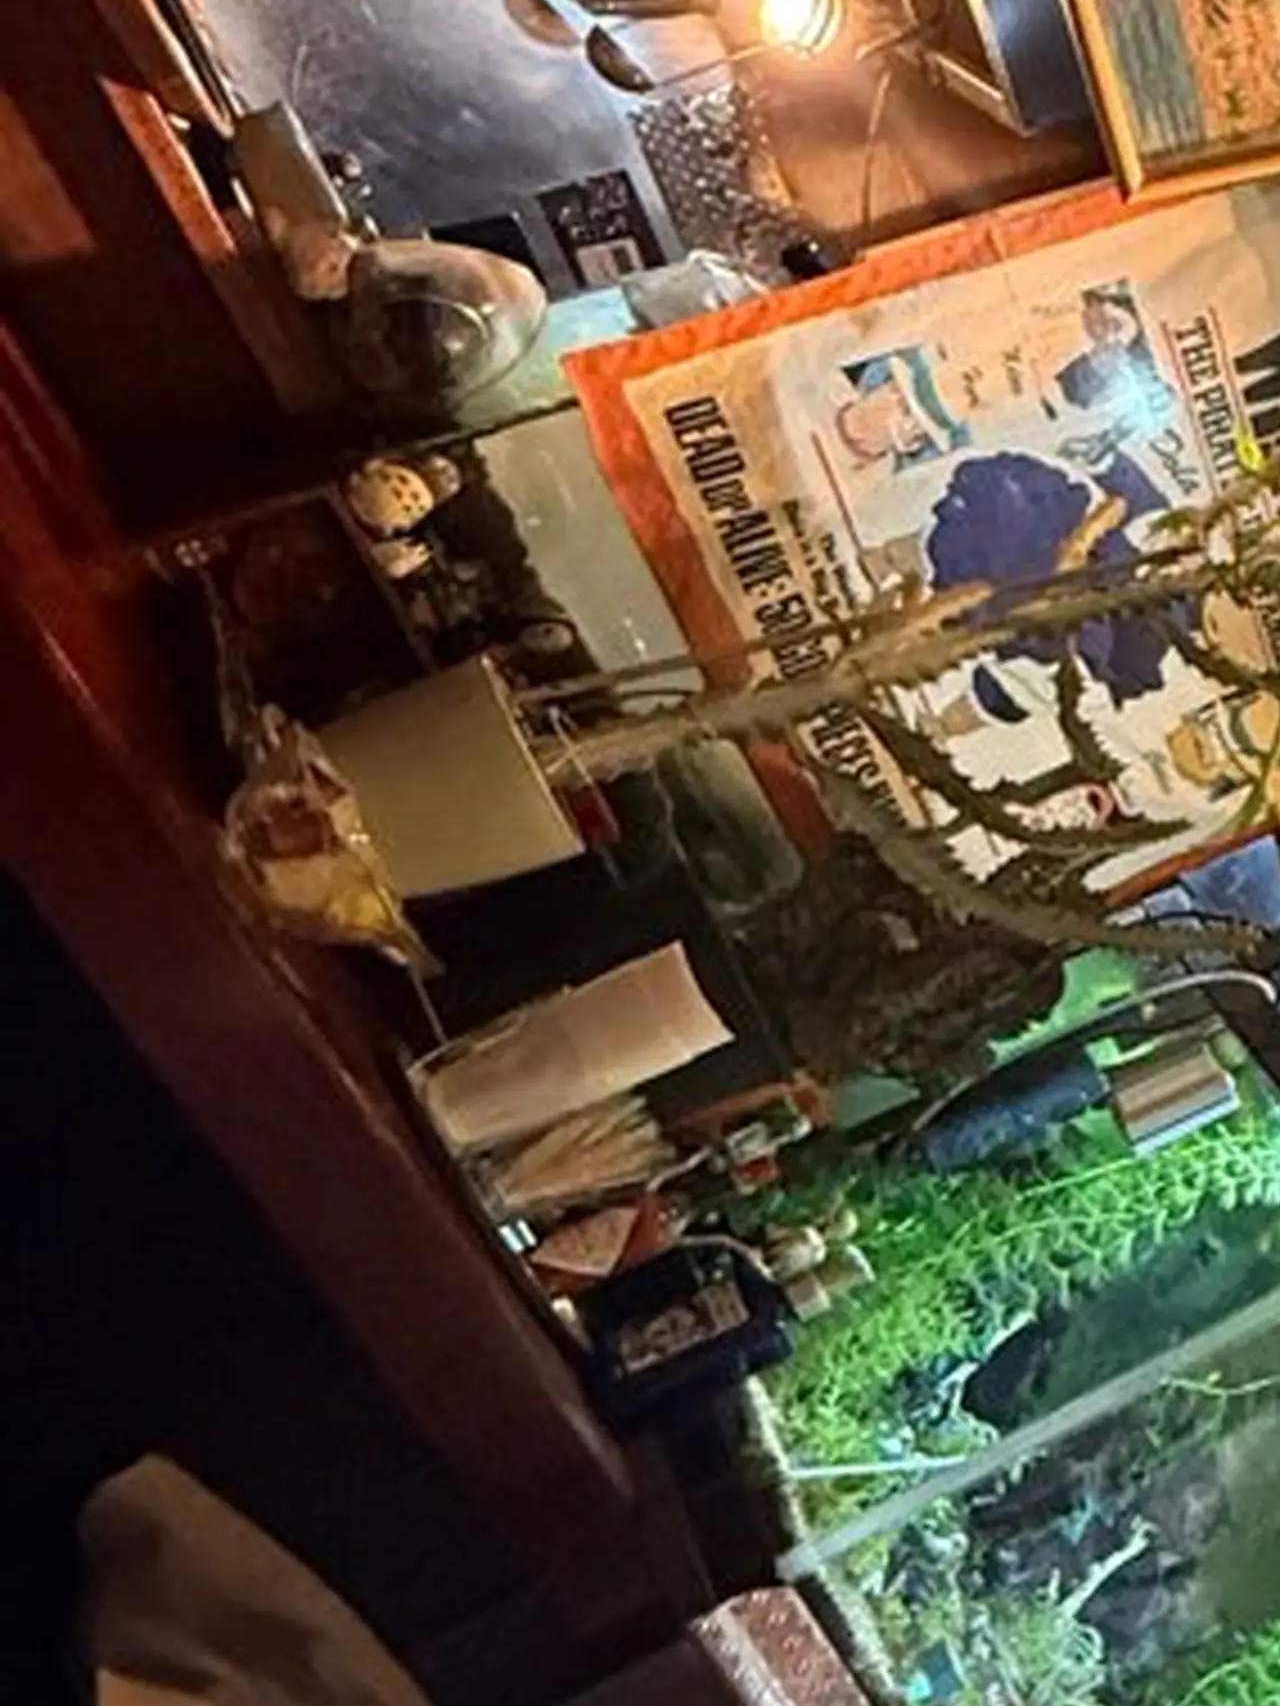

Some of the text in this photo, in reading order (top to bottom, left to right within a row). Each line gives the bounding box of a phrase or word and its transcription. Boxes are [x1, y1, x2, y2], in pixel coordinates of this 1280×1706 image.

[1173, 316, 1222, 387] THE
[664, 396, 747, 489] DEAD
[1193, 384, 1254, 494] PIRAT
